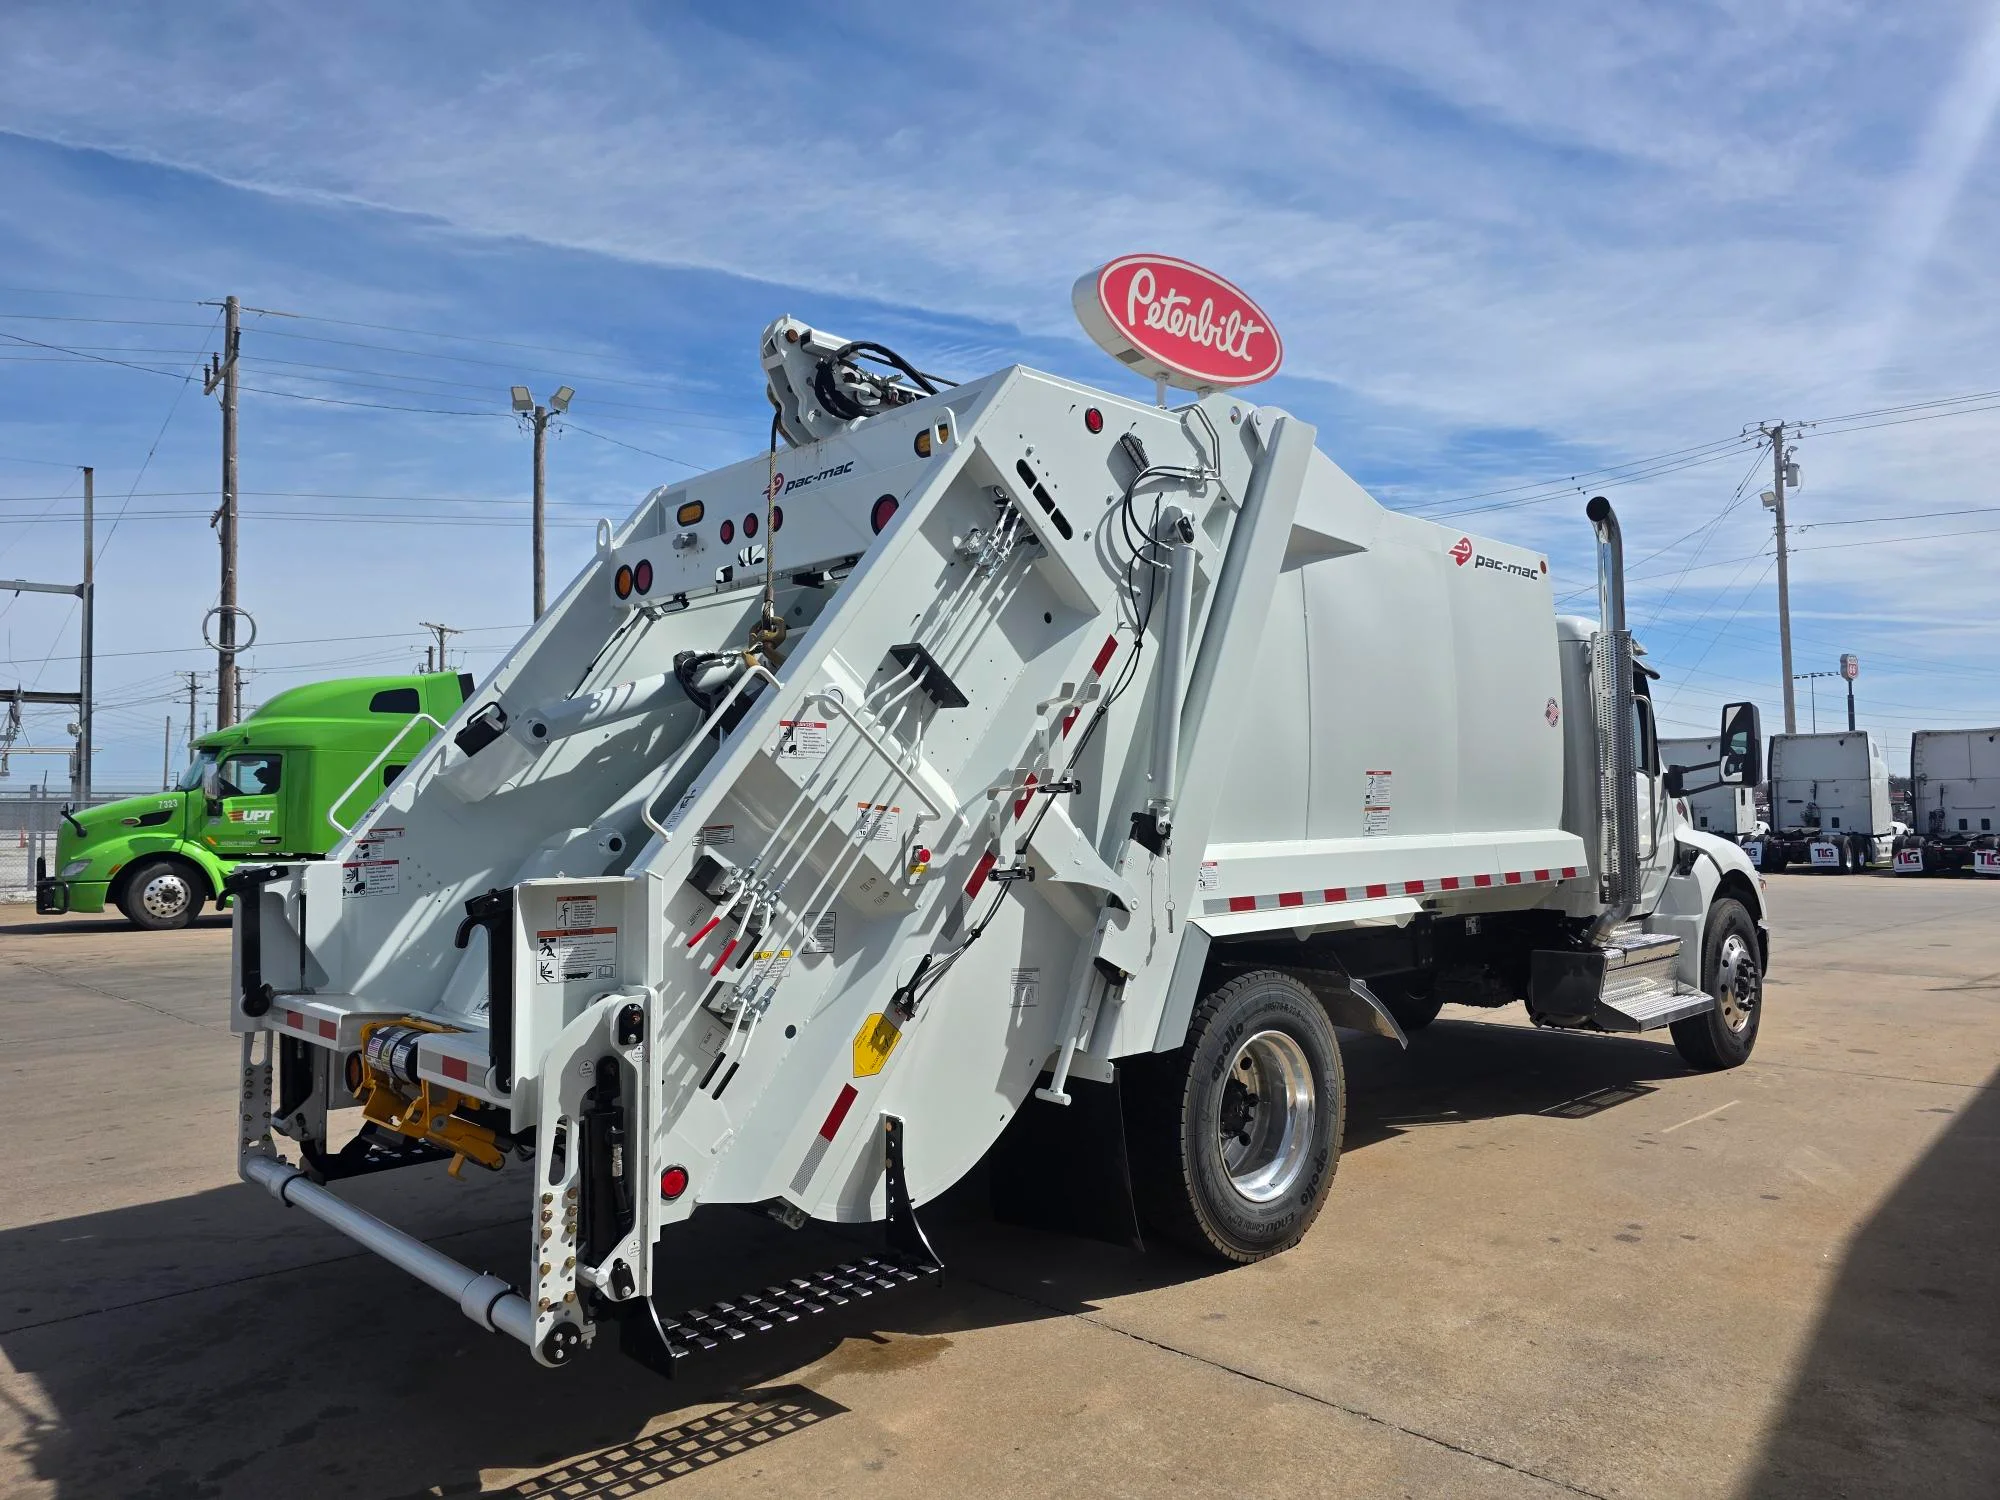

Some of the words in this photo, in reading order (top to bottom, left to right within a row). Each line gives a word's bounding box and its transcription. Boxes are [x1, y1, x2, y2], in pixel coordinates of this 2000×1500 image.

[1127, 267, 1265, 362] Peterbilt
[784, 461, 854, 495] pac-mac
[1474, 554, 1539, 581] pac-mac
[159, 799, 178, 809] 7323
[242, 810, 275, 821] UPT
[1814, 848, 1834, 858] TLG
[1896, 851, 1920, 865] TLG
[1211, 1022, 1244, 1082] apollo
[1300, 1147, 1329, 1206] apollo
